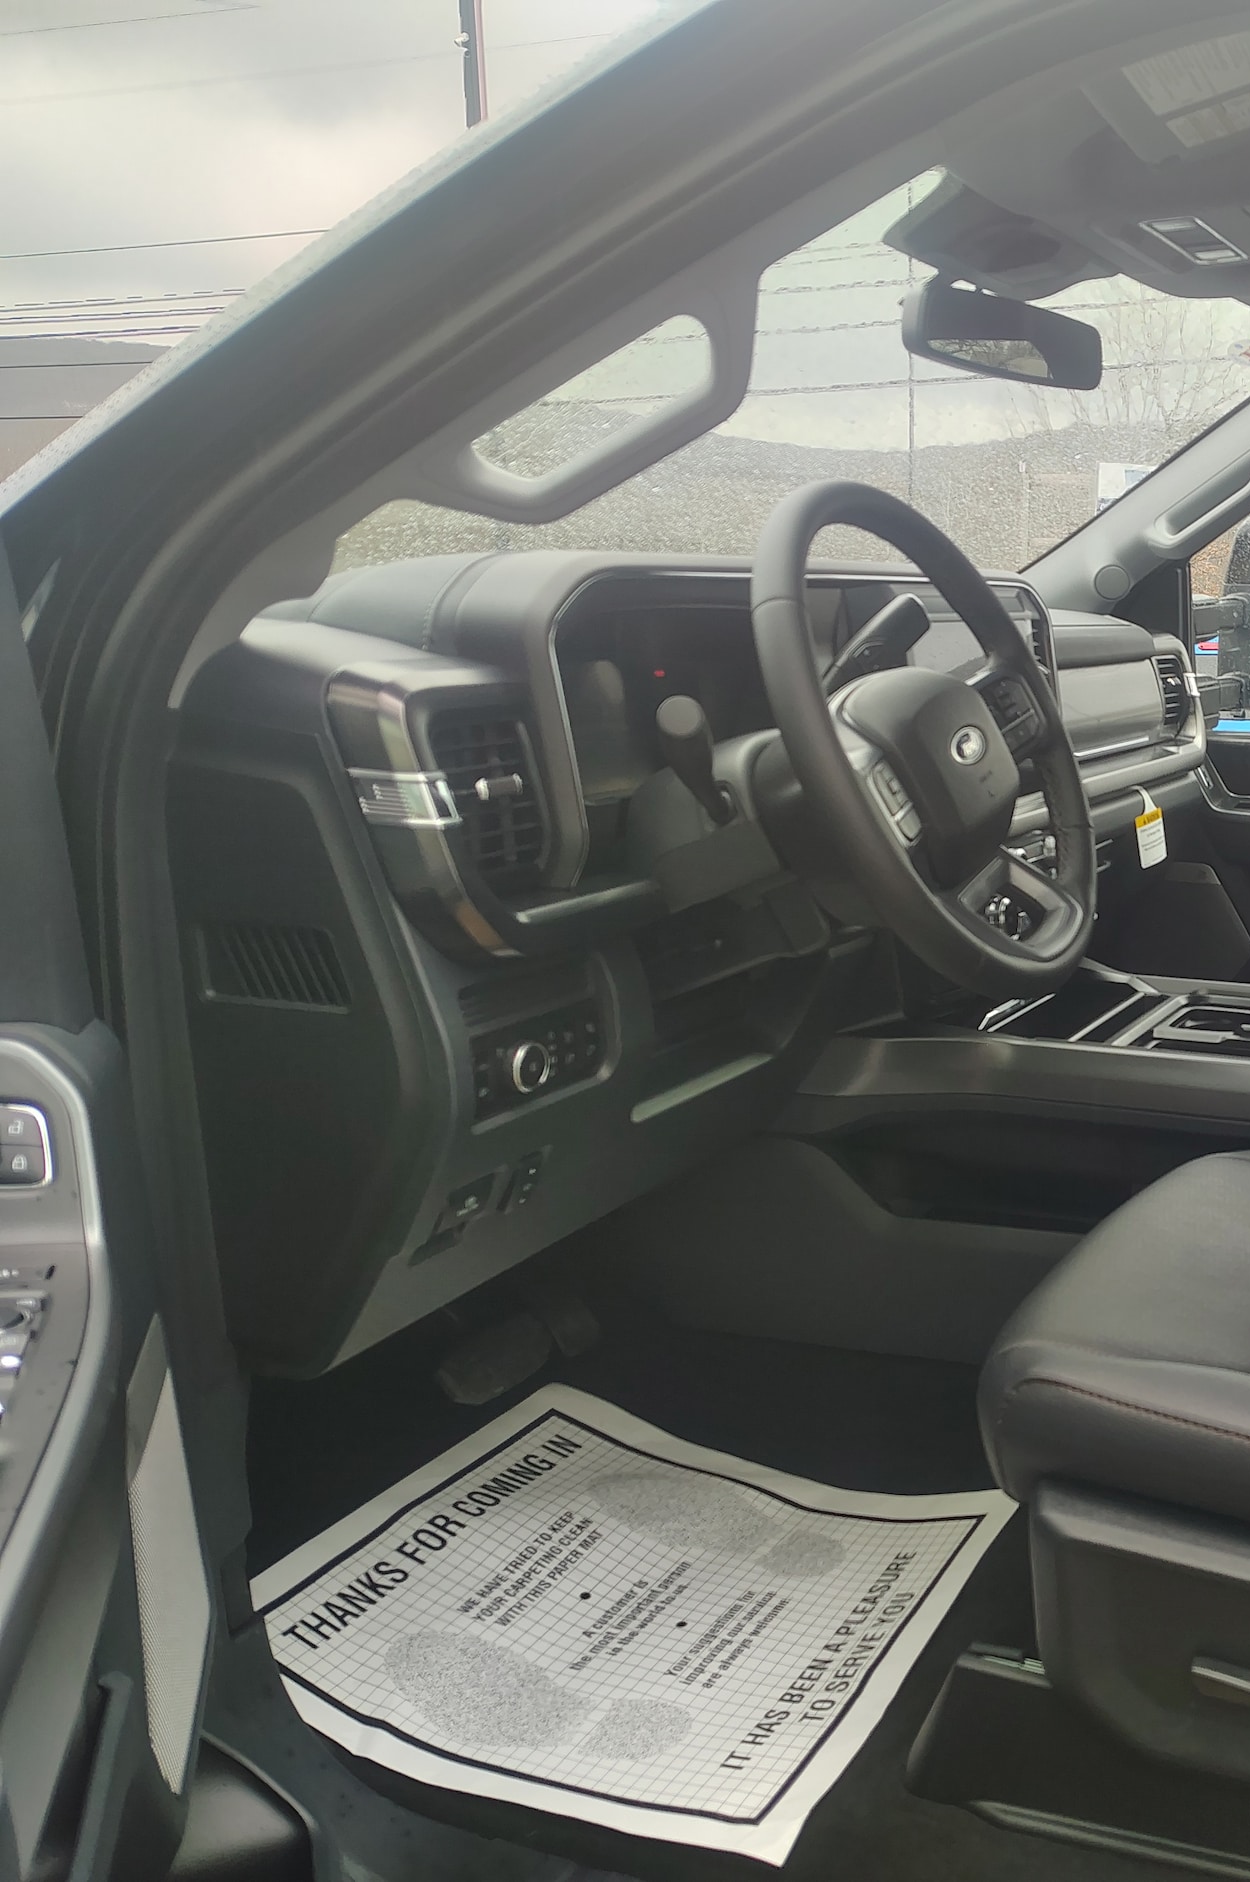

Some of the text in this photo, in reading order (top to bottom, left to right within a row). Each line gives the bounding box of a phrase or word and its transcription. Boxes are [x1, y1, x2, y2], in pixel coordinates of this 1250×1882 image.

[282, 1434, 582, 1650] THANKS FOR COMING IN
[457, 1511, 575, 1613] WE HAVE TRIED TO KEEP
[472, 1517, 594, 1622] YOUR CARPETING CLEAN
[495, 1529, 603, 1627] WITH THIS PAPER MAT
[569, 1655, 592, 1671] the
[589, 1631, 618, 1654] most
[614, 1589, 660, 1630] important
[582, 1580, 649, 1639] A customer is
[606, 1647, 623, 1656] in
[617, 1630, 639, 1645] the
[635, 1605, 666, 1629] world
[660, 1596, 676, 1605] to
[663, 1590, 756, 1677] Your suggestions for
[679, 1638, 733, 1686] improving
[727, 1622, 745, 1638] our
[701, 1672, 722, 1689] are
[718, 1638, 753, 1671] always
[719, 1551, 917, 1770] IT HAS BEEN A PLEASURE
[799, 1591, 916, 1722] TO SERVE YOU
